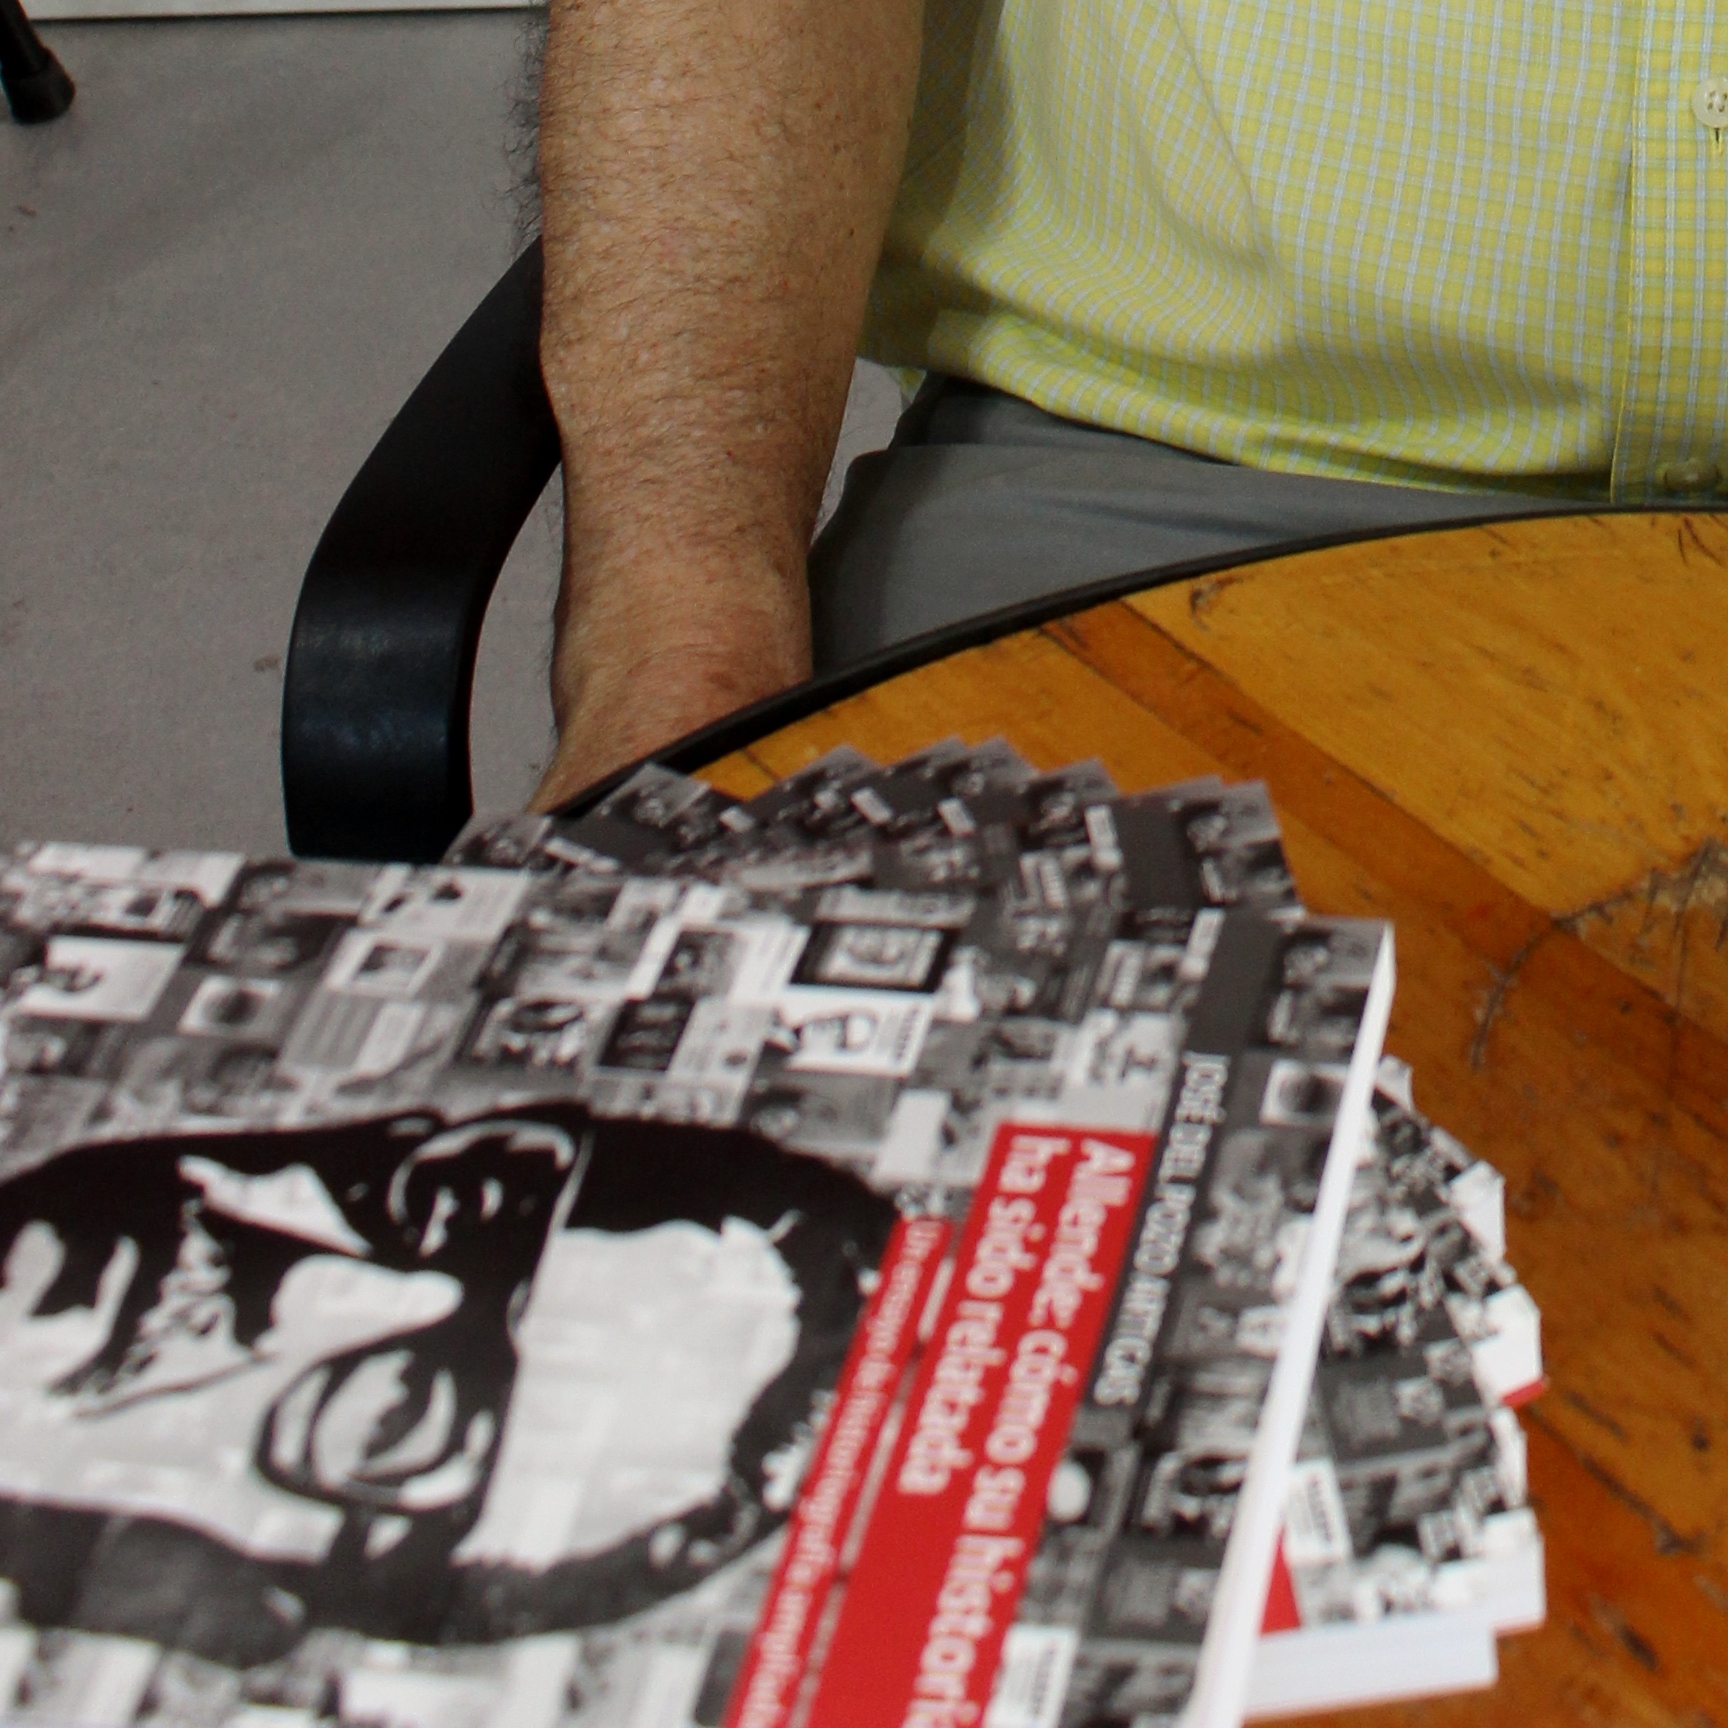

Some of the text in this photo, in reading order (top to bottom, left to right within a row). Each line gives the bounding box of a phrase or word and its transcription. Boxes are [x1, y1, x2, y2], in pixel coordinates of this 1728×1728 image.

[904, 1219, 942, 1263] Un
[1033, 1133, 1135, 1330] Allende:
[1092, 1052, 1230, 1406] JOSÉ DEL POZO ARTIGAS
[898, 1133, 1071, 1494] ha sido relatada
[984, 1328, 1080, 1465] cómo
[962, 1466, 1026, 1530] su
